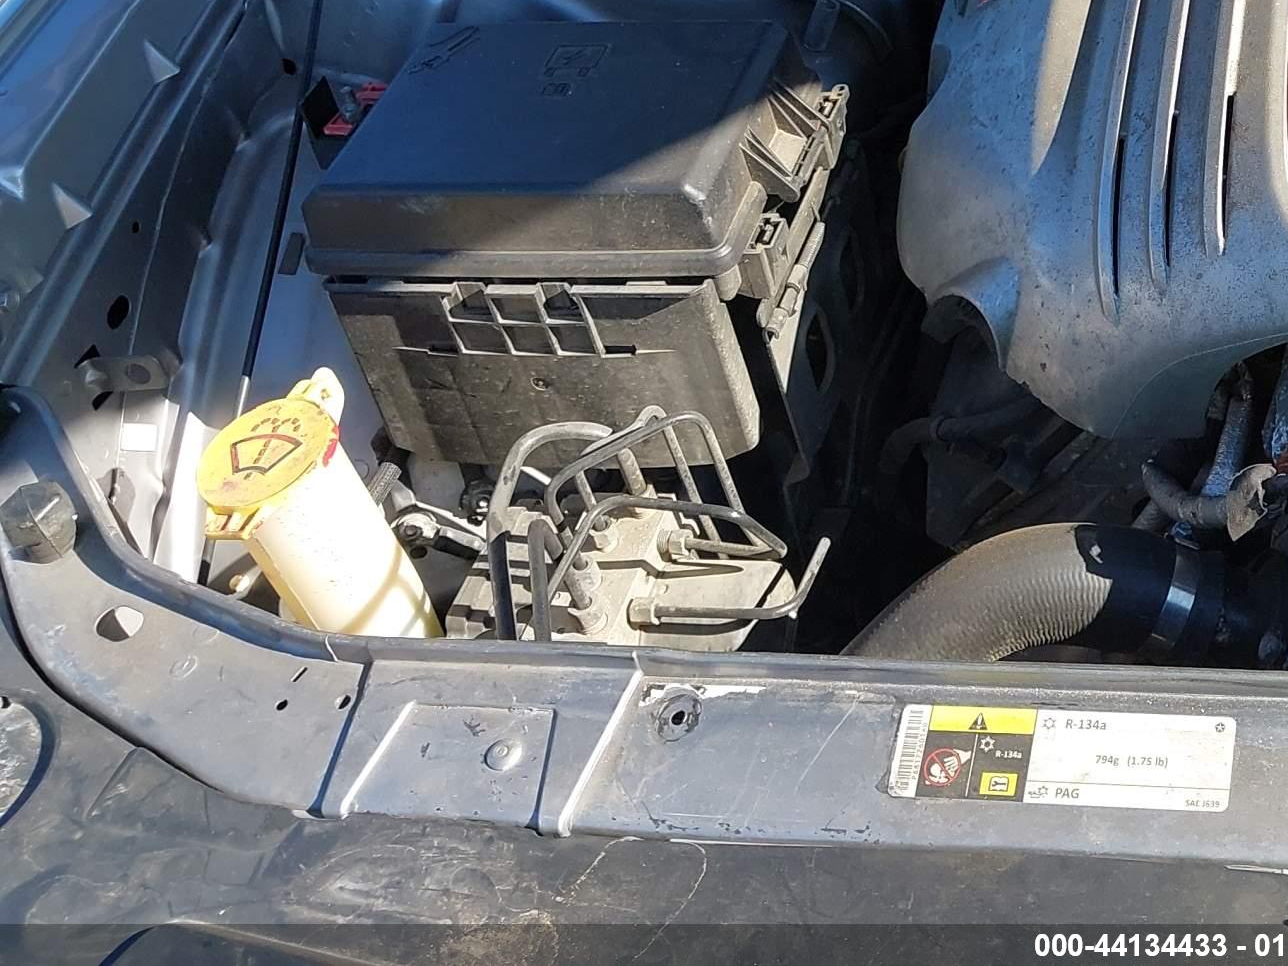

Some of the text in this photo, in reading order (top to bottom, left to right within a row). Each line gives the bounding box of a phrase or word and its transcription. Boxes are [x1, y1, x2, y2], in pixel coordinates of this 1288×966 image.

[1065, 718, 1107, 731] R-134a
[995, 750, 1022, 760] R-134a
[1095, 754, 1168, 768] 794g (1.75 lb)
[1055, 787, 1080, 800] PAG
